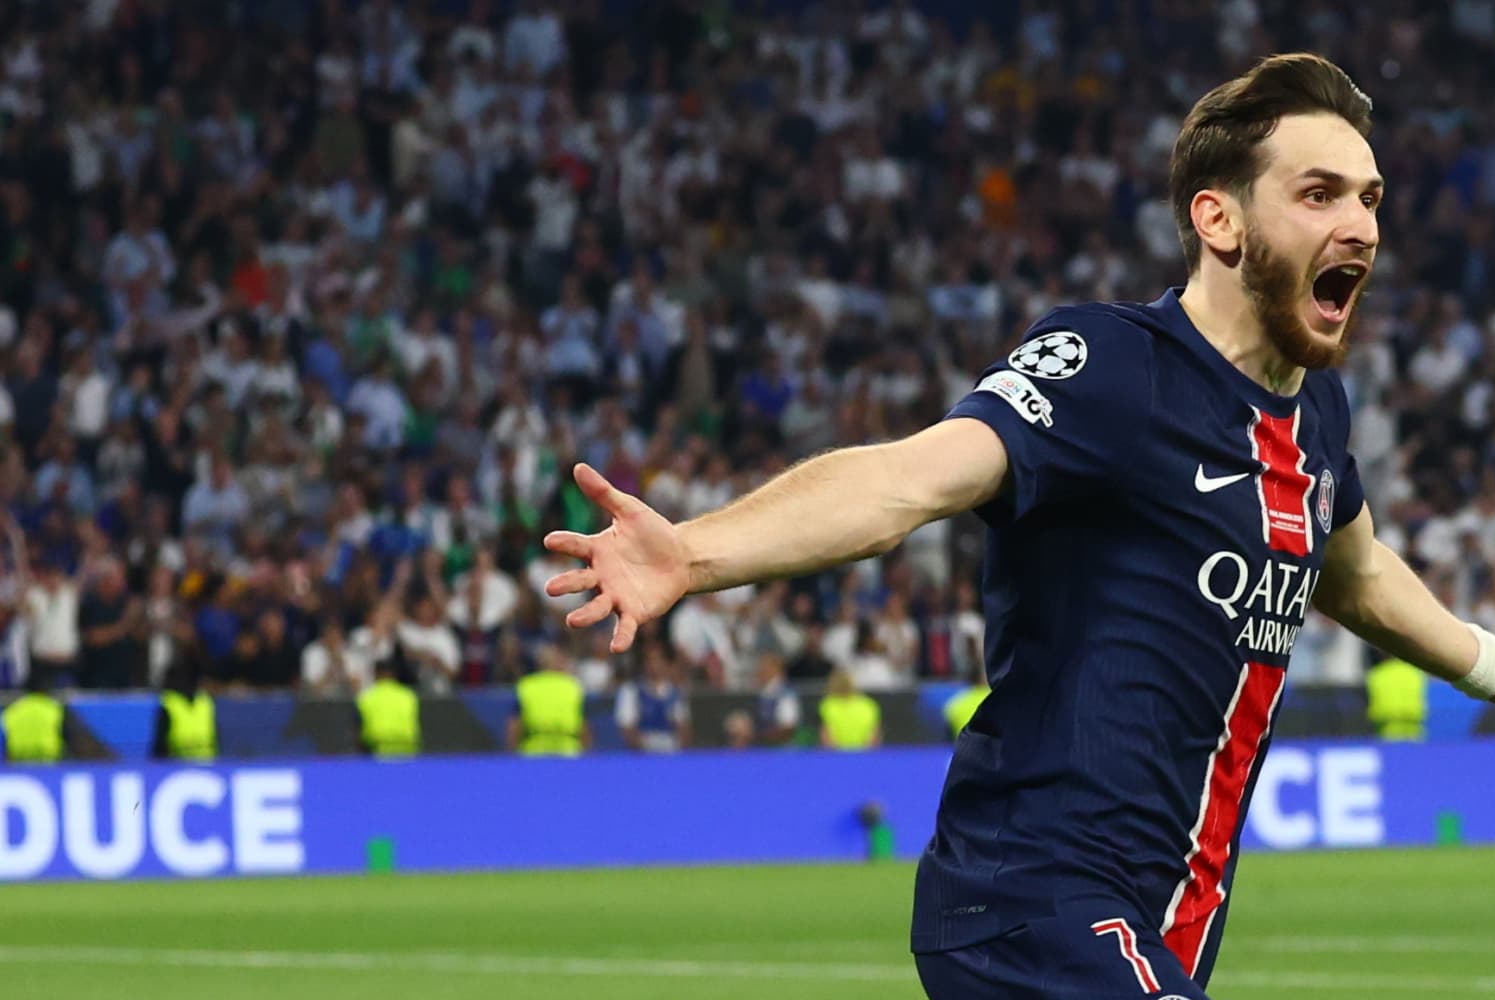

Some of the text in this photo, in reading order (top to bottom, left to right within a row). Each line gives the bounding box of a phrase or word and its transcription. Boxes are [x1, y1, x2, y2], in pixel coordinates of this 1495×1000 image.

[1197, 550, 1320, 620] QATA
[1234, 616, 1300, 655] AIRWA
[0, 768, 305, 879] DUCE
[1250, 747, 1385, 849] CE
[1090, 917, 1162, 994] 7
